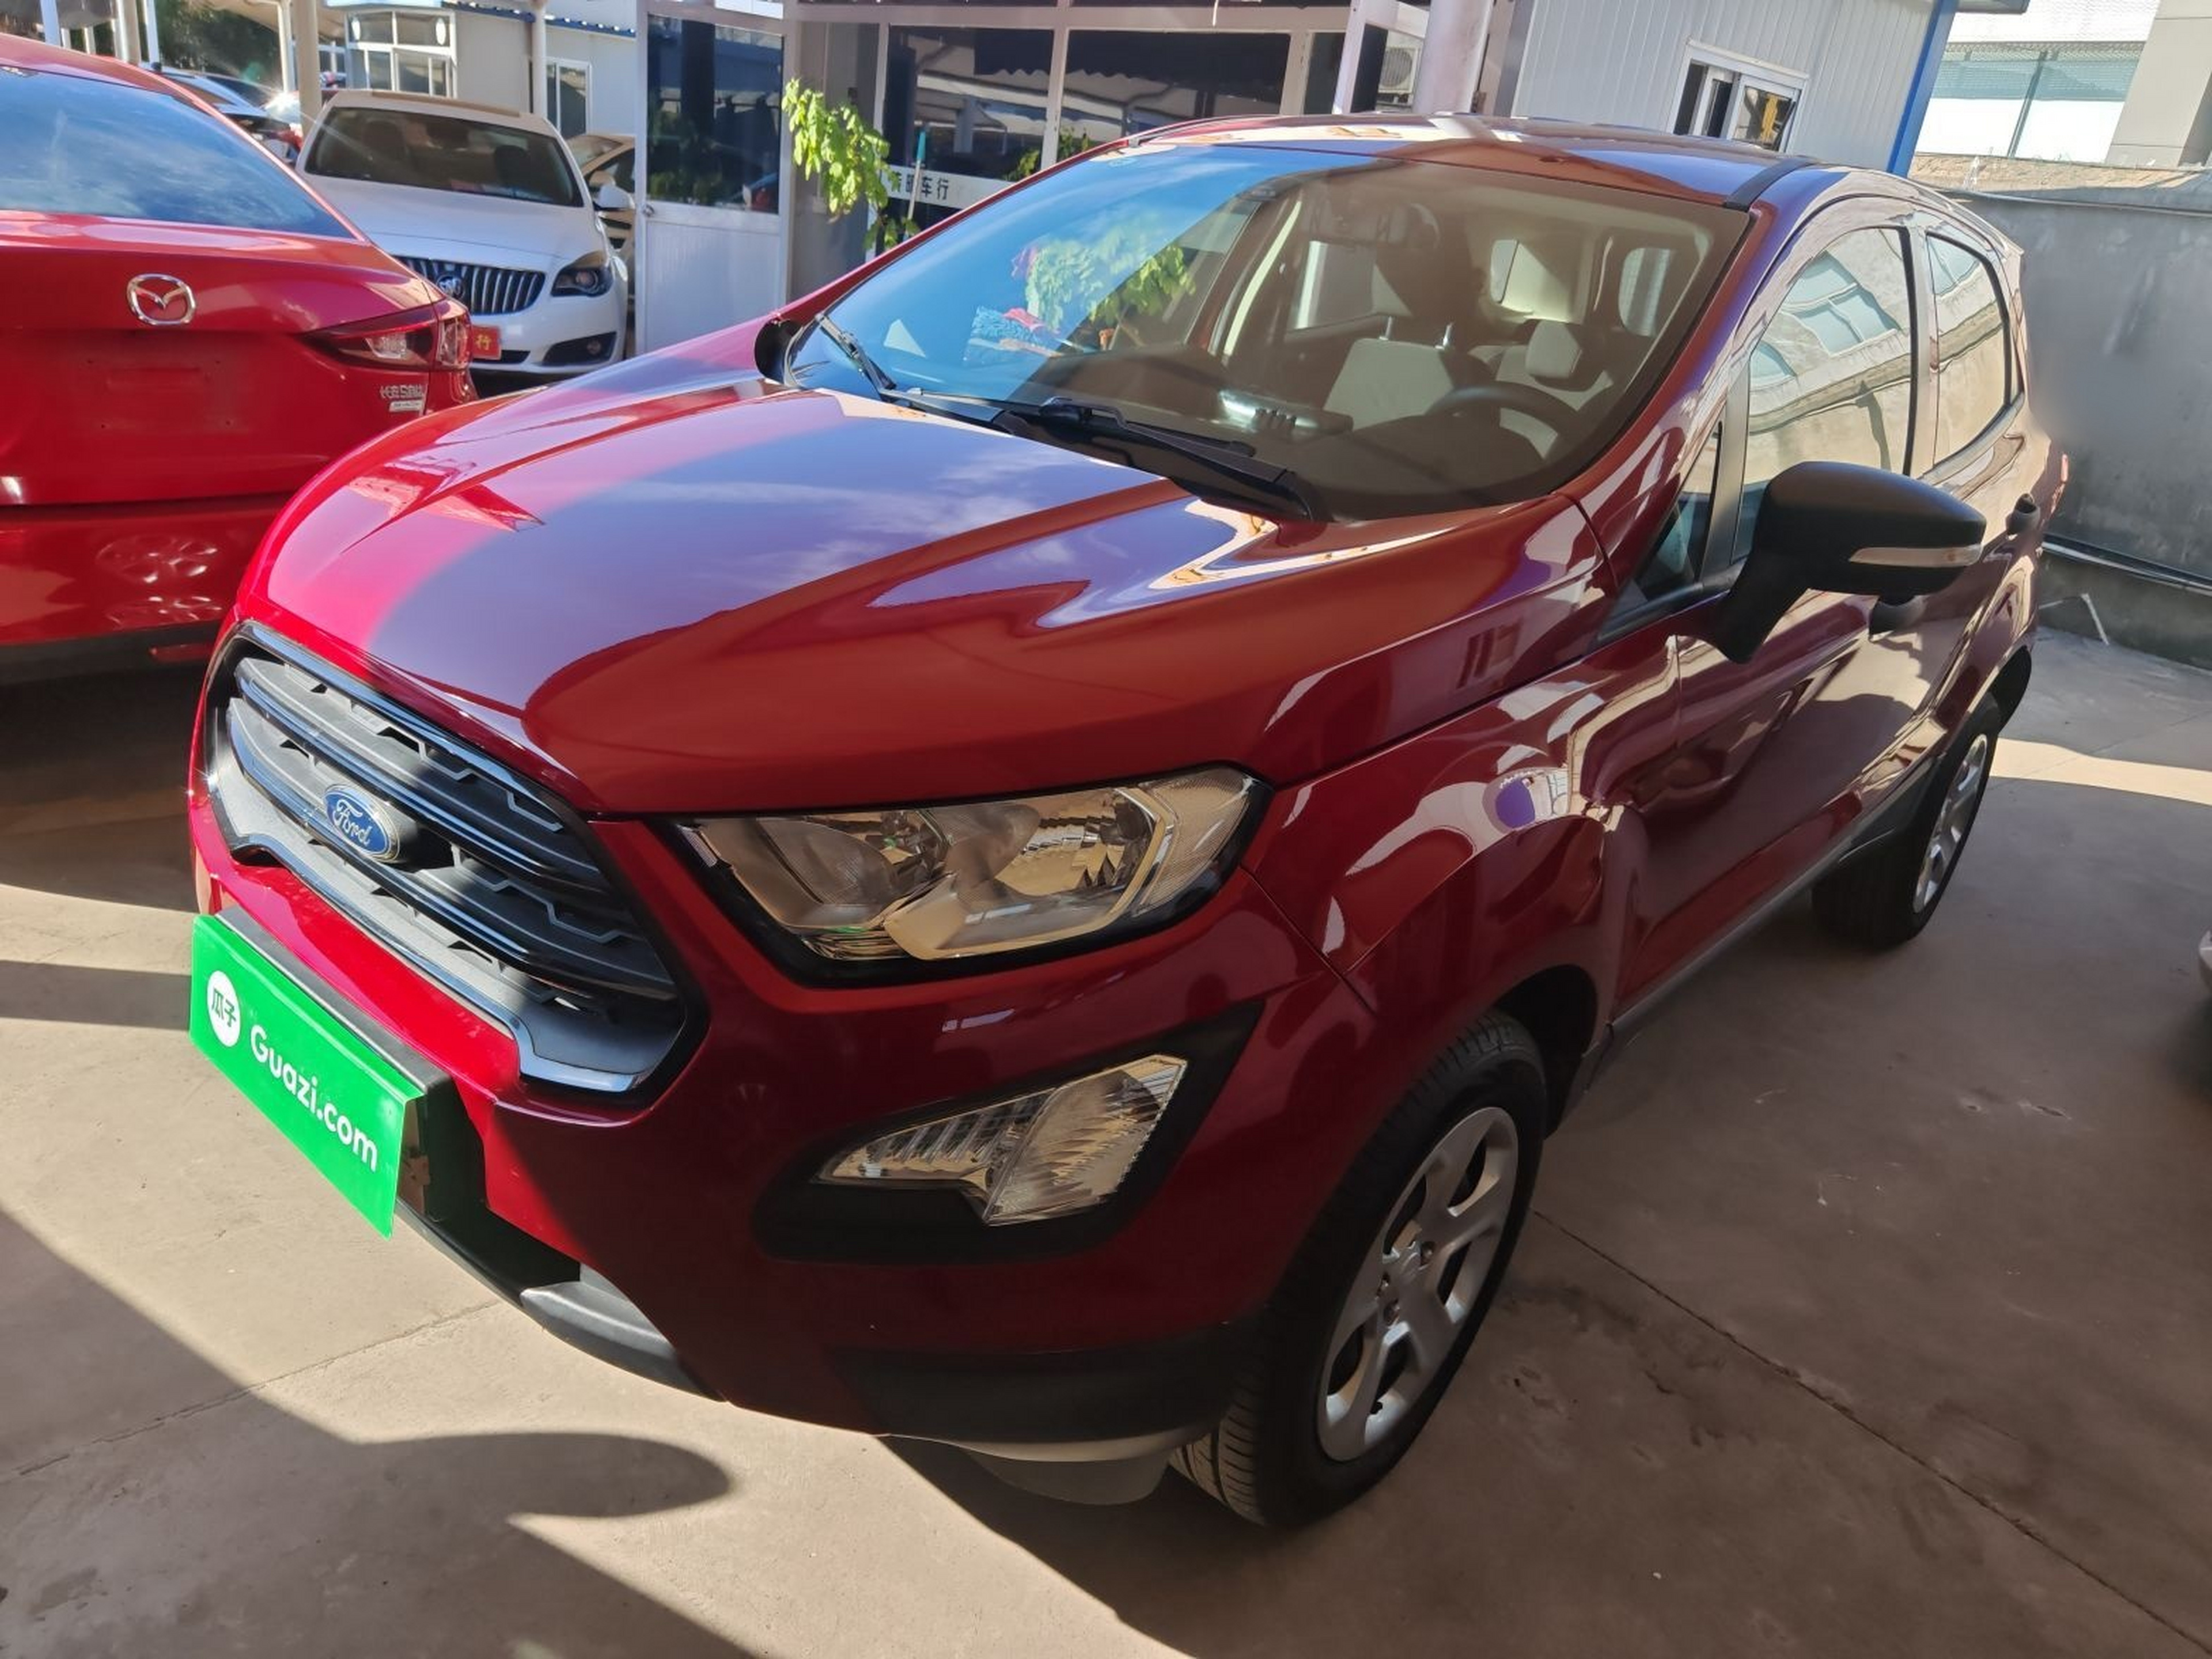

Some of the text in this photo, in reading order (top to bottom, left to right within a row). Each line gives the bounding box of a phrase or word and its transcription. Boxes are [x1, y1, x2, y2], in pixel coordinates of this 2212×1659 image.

[888, 171, 949, 200] 车行
[332, 798, 373, 846] Ford
[211, 986, 378, 1172] 瓜子 Guazi.com
